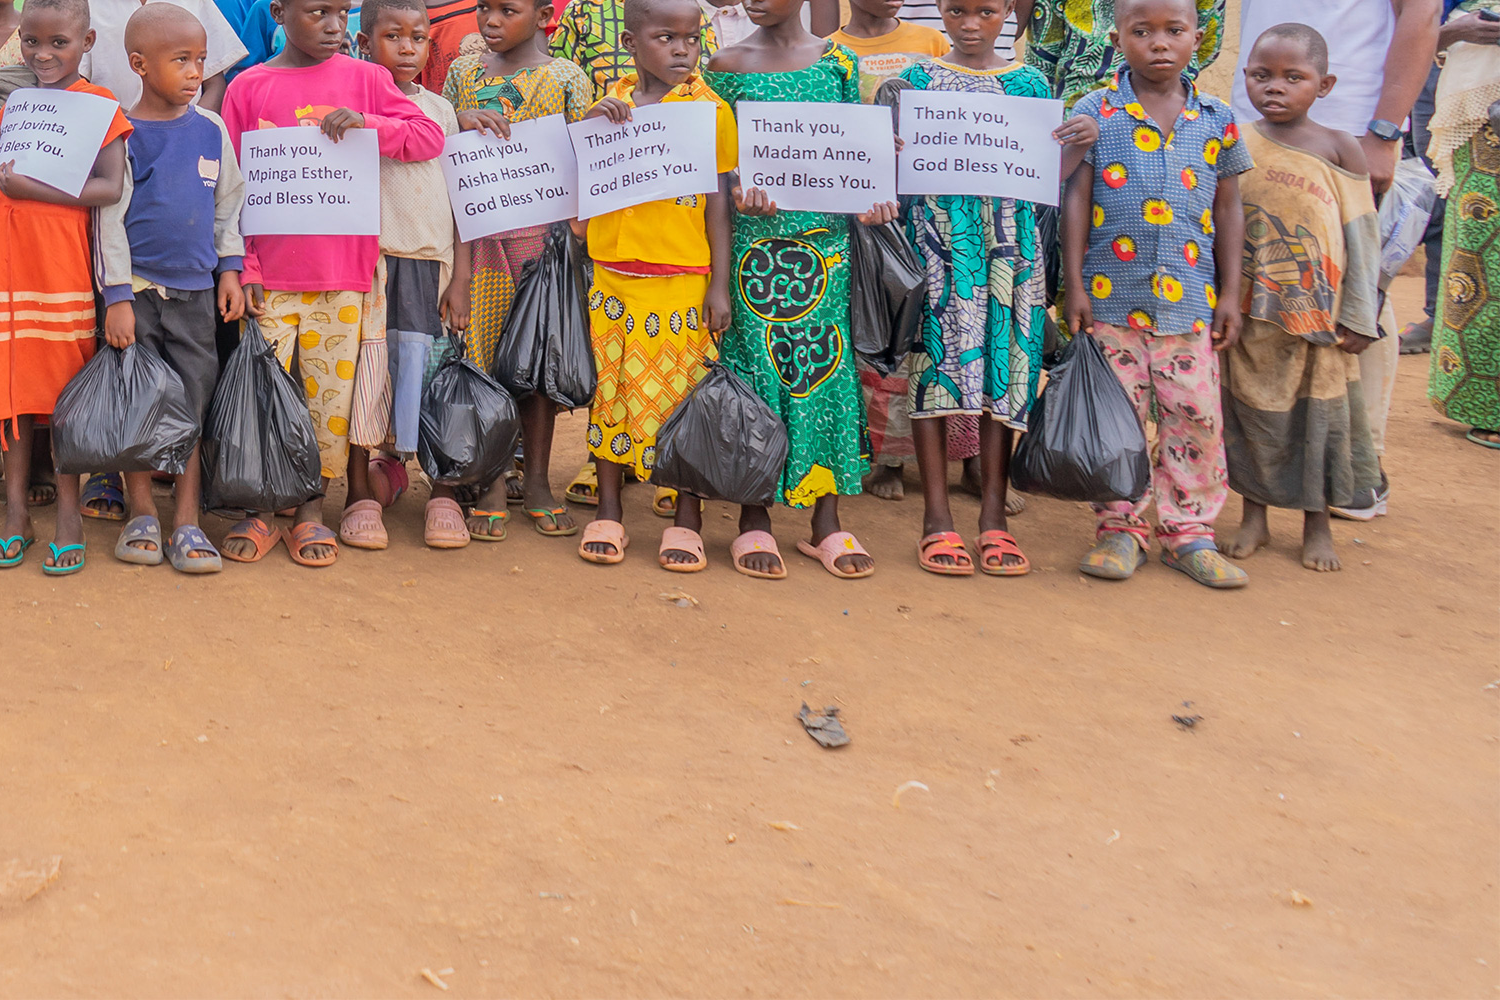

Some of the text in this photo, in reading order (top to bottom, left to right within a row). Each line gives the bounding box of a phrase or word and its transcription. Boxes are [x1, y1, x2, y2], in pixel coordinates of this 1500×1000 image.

[864, 57, 907, 66] THOMAS
[31, 103, 58, 114] you,
[913, 106, 1009, 127] Thank you,
[18, 120, 68, 136] Jovinta,
[584, 121, 666, 148] Thank you,
[751, 118, 845, 137] Thank you,
[4, 140, 32, 153] Bless
[35, 140, 64, 157] You.
[250, 143, 322, 158] Thank you,
[912, 131, 1024, 153] Jodie Mbula,
[448, 142, 528, 166] Thank you,
[590, 143, 670, 172] uncle Jerry,
[753, 145, 871, 164] Madam Anne,
[248, 166, 353, 183] Mpinga Esther,
[458, 162, 555, 191] Aisha Hassan,
[912, 157, 1040, 179] God Bless You.
[590, 162, 698, 196] God Bless You.
[752, 172, 876, 189] God Bless You.
[1265, 169, 1336, 208] SODA MILK
[247, 191, 351, 206] God Bless You.
[464, 186, 569, 216] God Bless You.
